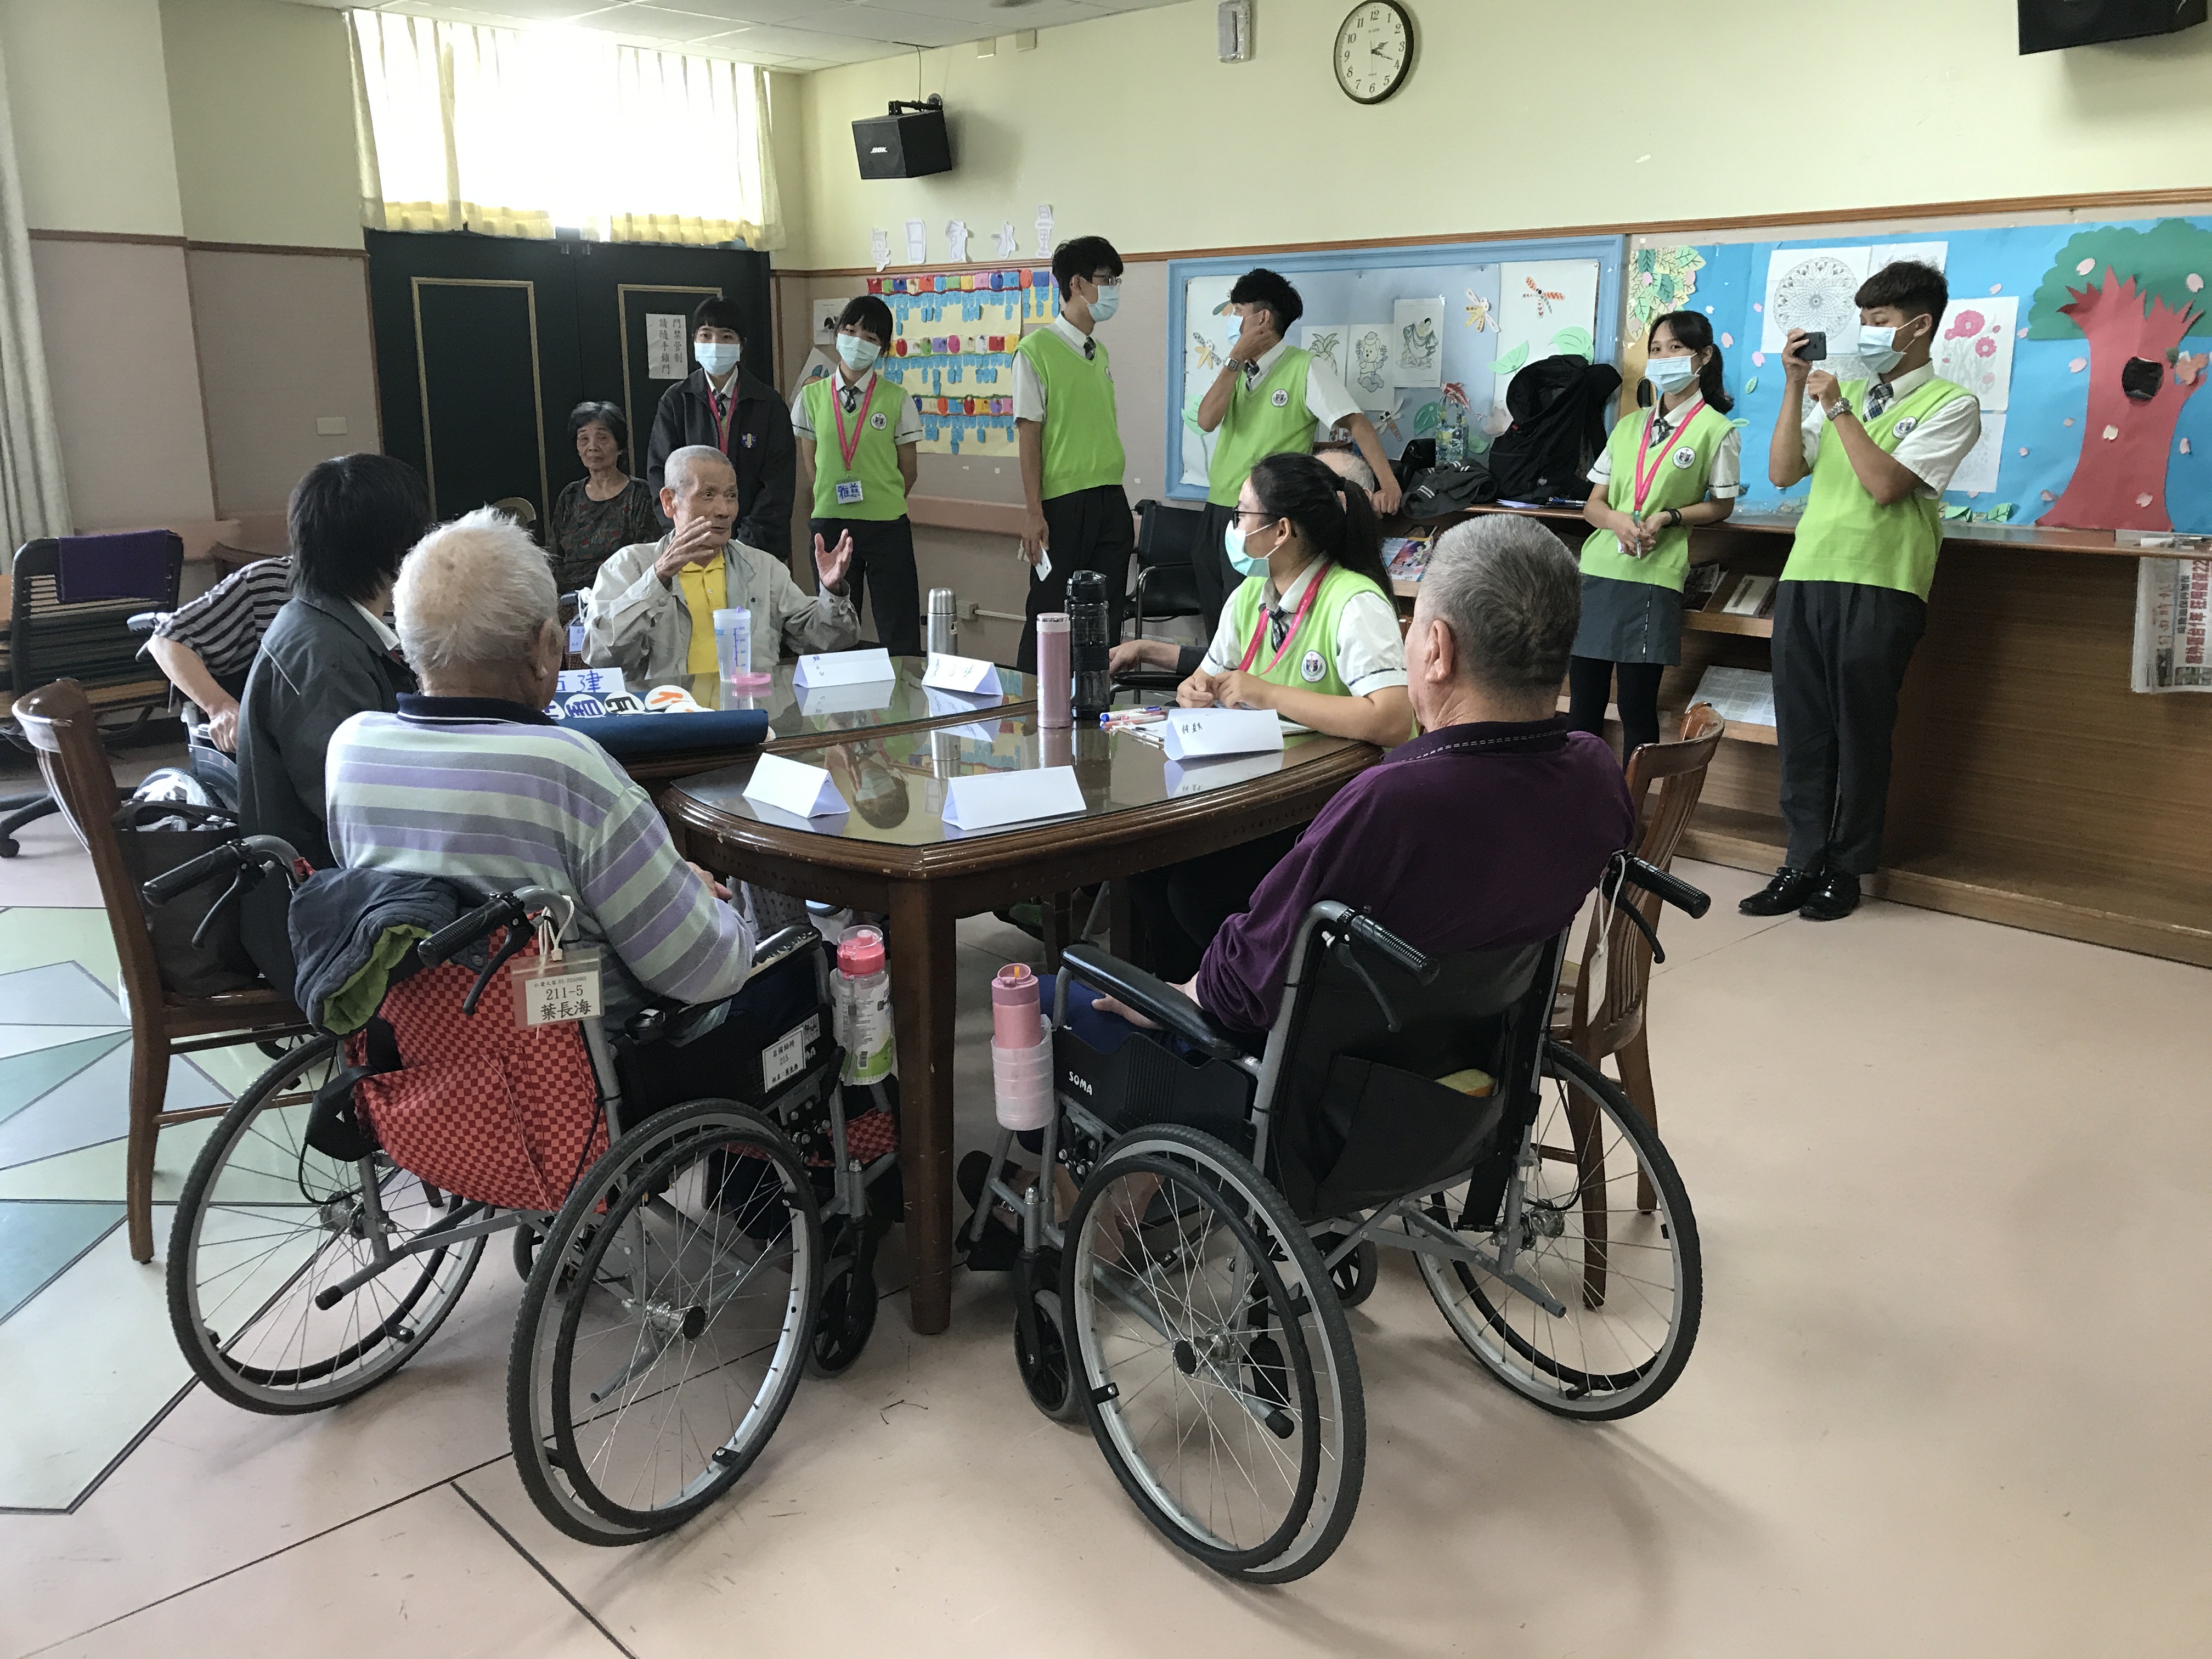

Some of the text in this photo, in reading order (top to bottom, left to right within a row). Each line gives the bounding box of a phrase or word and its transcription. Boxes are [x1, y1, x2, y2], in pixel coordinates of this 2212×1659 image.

[1370, 9, 1380, 21] 12
[1387, 13, 1391, 23] 1
[1357, 17, 1364, 28] 11
[1394, 23, 1402, 34] 2
[1347, 32, 1357, 44] 10
[1398, 41, 1405, 52] 3
[1344, 50, 1350, 63] 9
[1393, 59, 1400, 70] 4
[1346, 65, 1353, 78] 8
[1356, 79, 1362, 89] 7
[1383, 74, 1390, 86] 5
[1369, 83, 1375, 93] 6
[659, 318, 670, 374] 請隨手鎖門
[673, 318, 682, 363] 門禁管制
[837, 482, 860, 499] 雅慈
[546, 985, 583, 1000] 211-5
[540, 999, 592, 1020] 葉長海
[1068, 1071, 1092, 1096] SOMA
